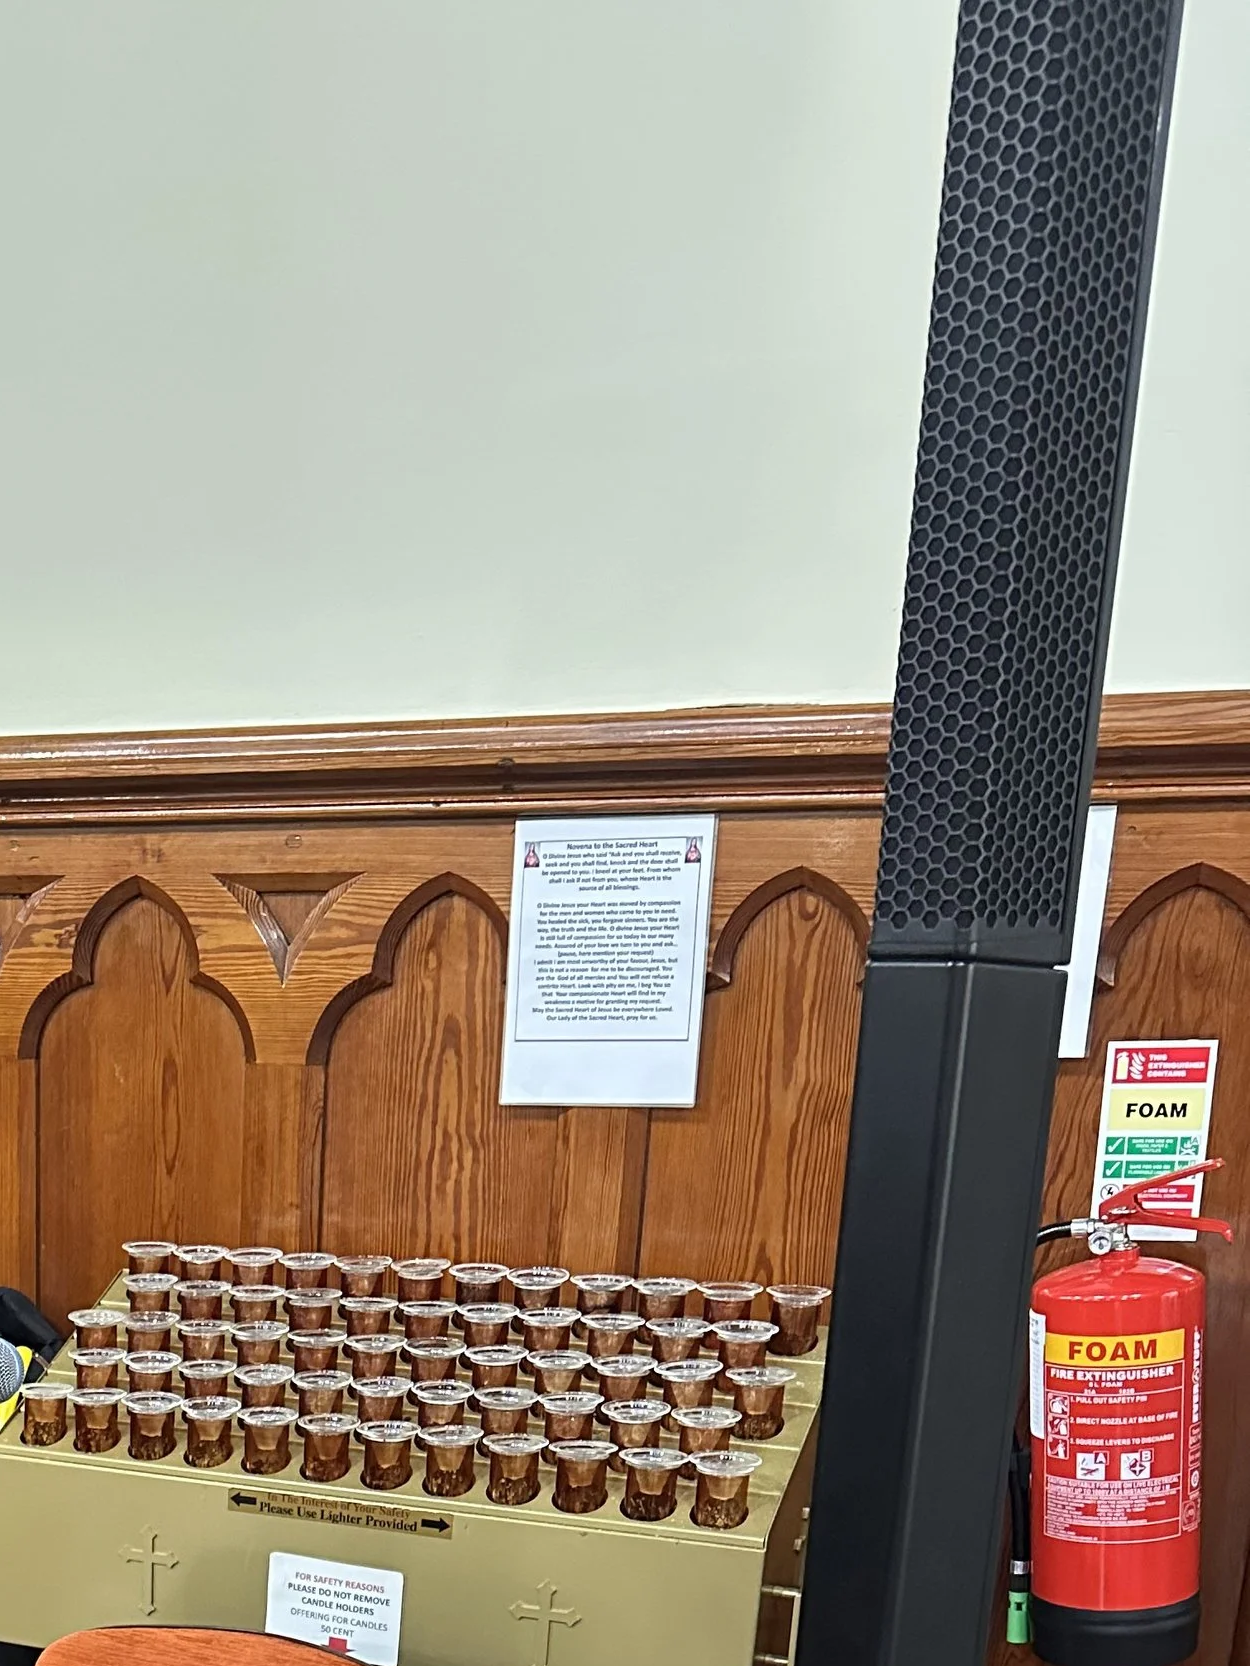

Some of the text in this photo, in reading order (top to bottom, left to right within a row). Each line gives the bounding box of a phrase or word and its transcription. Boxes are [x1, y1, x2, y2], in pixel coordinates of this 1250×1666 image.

[1126, 1103, 1187, 1118] FOAM
[1069, 1339, 1157, 1361] FOAM
[1050, 1366, 1174, 1381] FIRE EXTINGUISHER
[1076, 1396, 1092, 1404] PULL
[1108, 1396, 1134, 1404] SAFETY
[1101, 1417, 1128, 1426] NOZZLE
[1129, 1416, 1137, 1424] AT
[1138, 1415, 1155, 1423] BASE
[1157, 1413, 1164, 1422] OF
[1165, 1412, 1178, 1420] FIRE
[1076, 1439, 1105, 1447] SQUEEZE
[1106, 1437, 1130, 1447] LEVERS
[1131, 1437, 1140, 1445] TO
[1141, 1434, 1174, 1445] DISCHARGE
[1095, 1451, 1151, 1464] A B
[281, 1494, 299, 1504] The
[301, 1496, 339, 1509] Interest
[353, 1502, 376, 1515] Your
[379, 1506, 412, 1519] Safety
[260, 1502, 417, 1533] Please Use Lighter Provided
[295, 1572, 385, 1594] FOR SAFETY REASONS
[288, 1582, 391, 1606] PLEASE DO NOT REMOVE
[301, 1597, 374, 1616] CANDLE HOLDERS
[290, 1607, 388, 1632] OFFERING FOR CANDLES
[321, 1625, 354, 1638] 50 CENT
